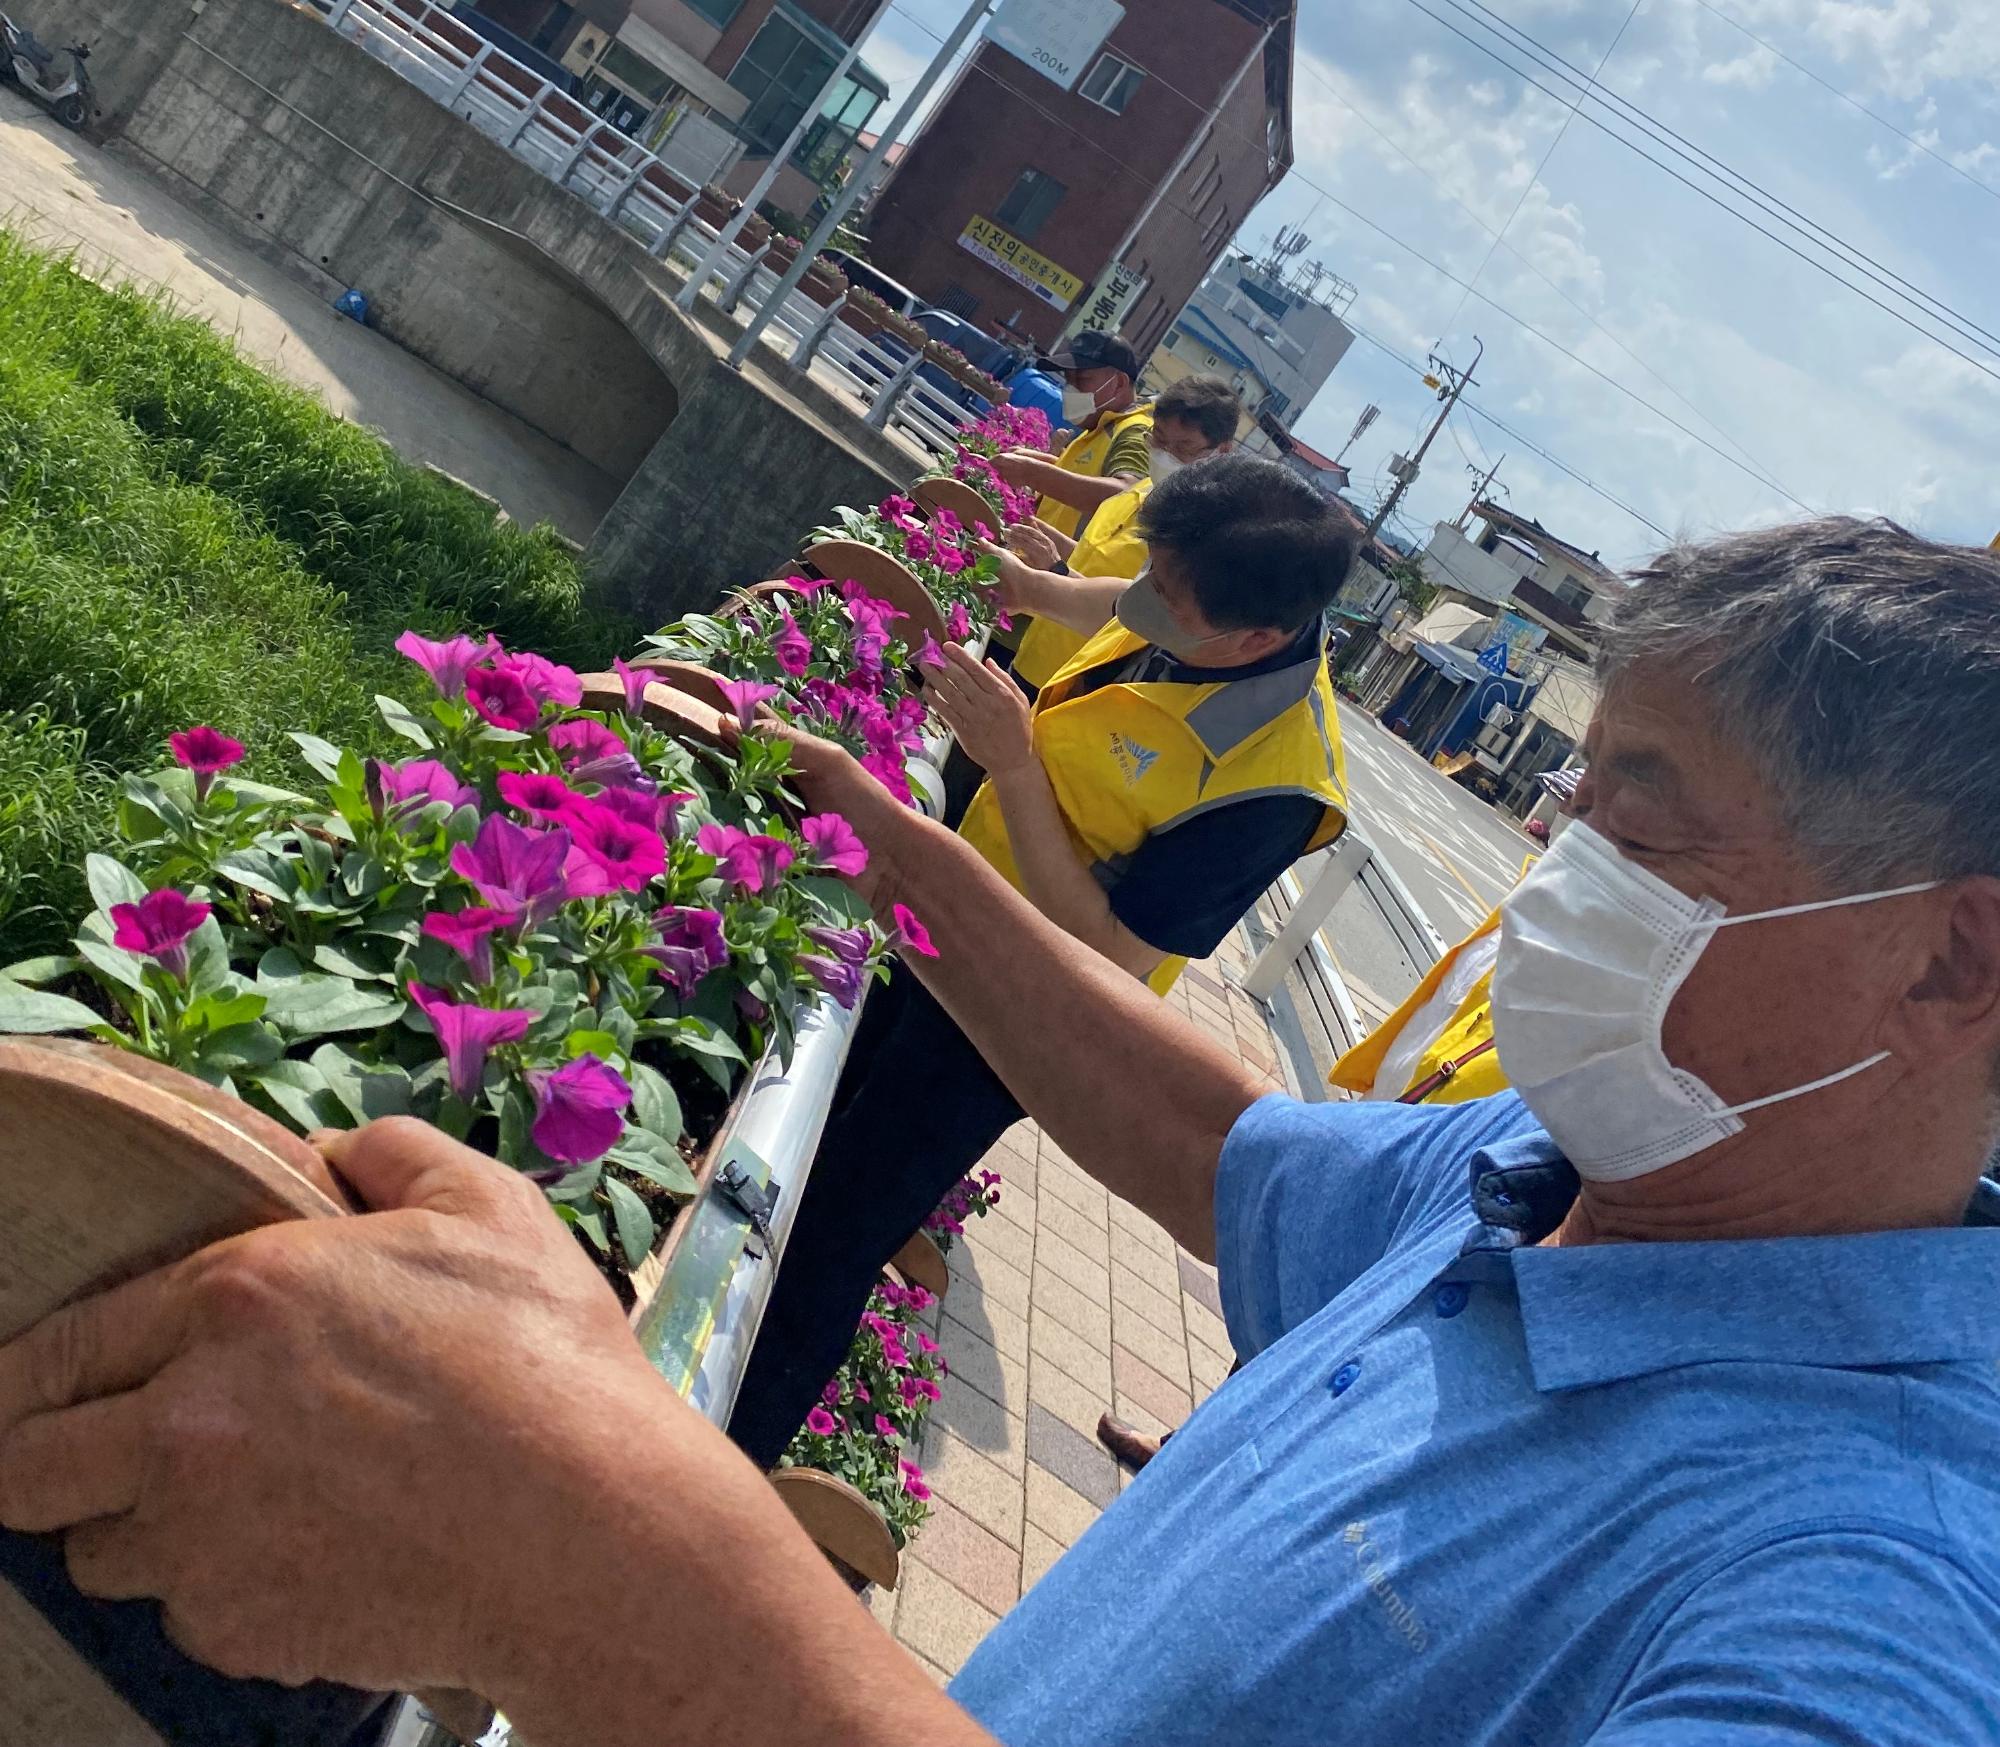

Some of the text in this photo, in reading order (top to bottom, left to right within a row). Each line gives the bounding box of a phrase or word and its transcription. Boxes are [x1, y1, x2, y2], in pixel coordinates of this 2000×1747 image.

[1031, 47, 1069, 77] 200M
[973, 221, 1021, 261] 신전의
[1018, 255, 1073, 294] 공인중개사
